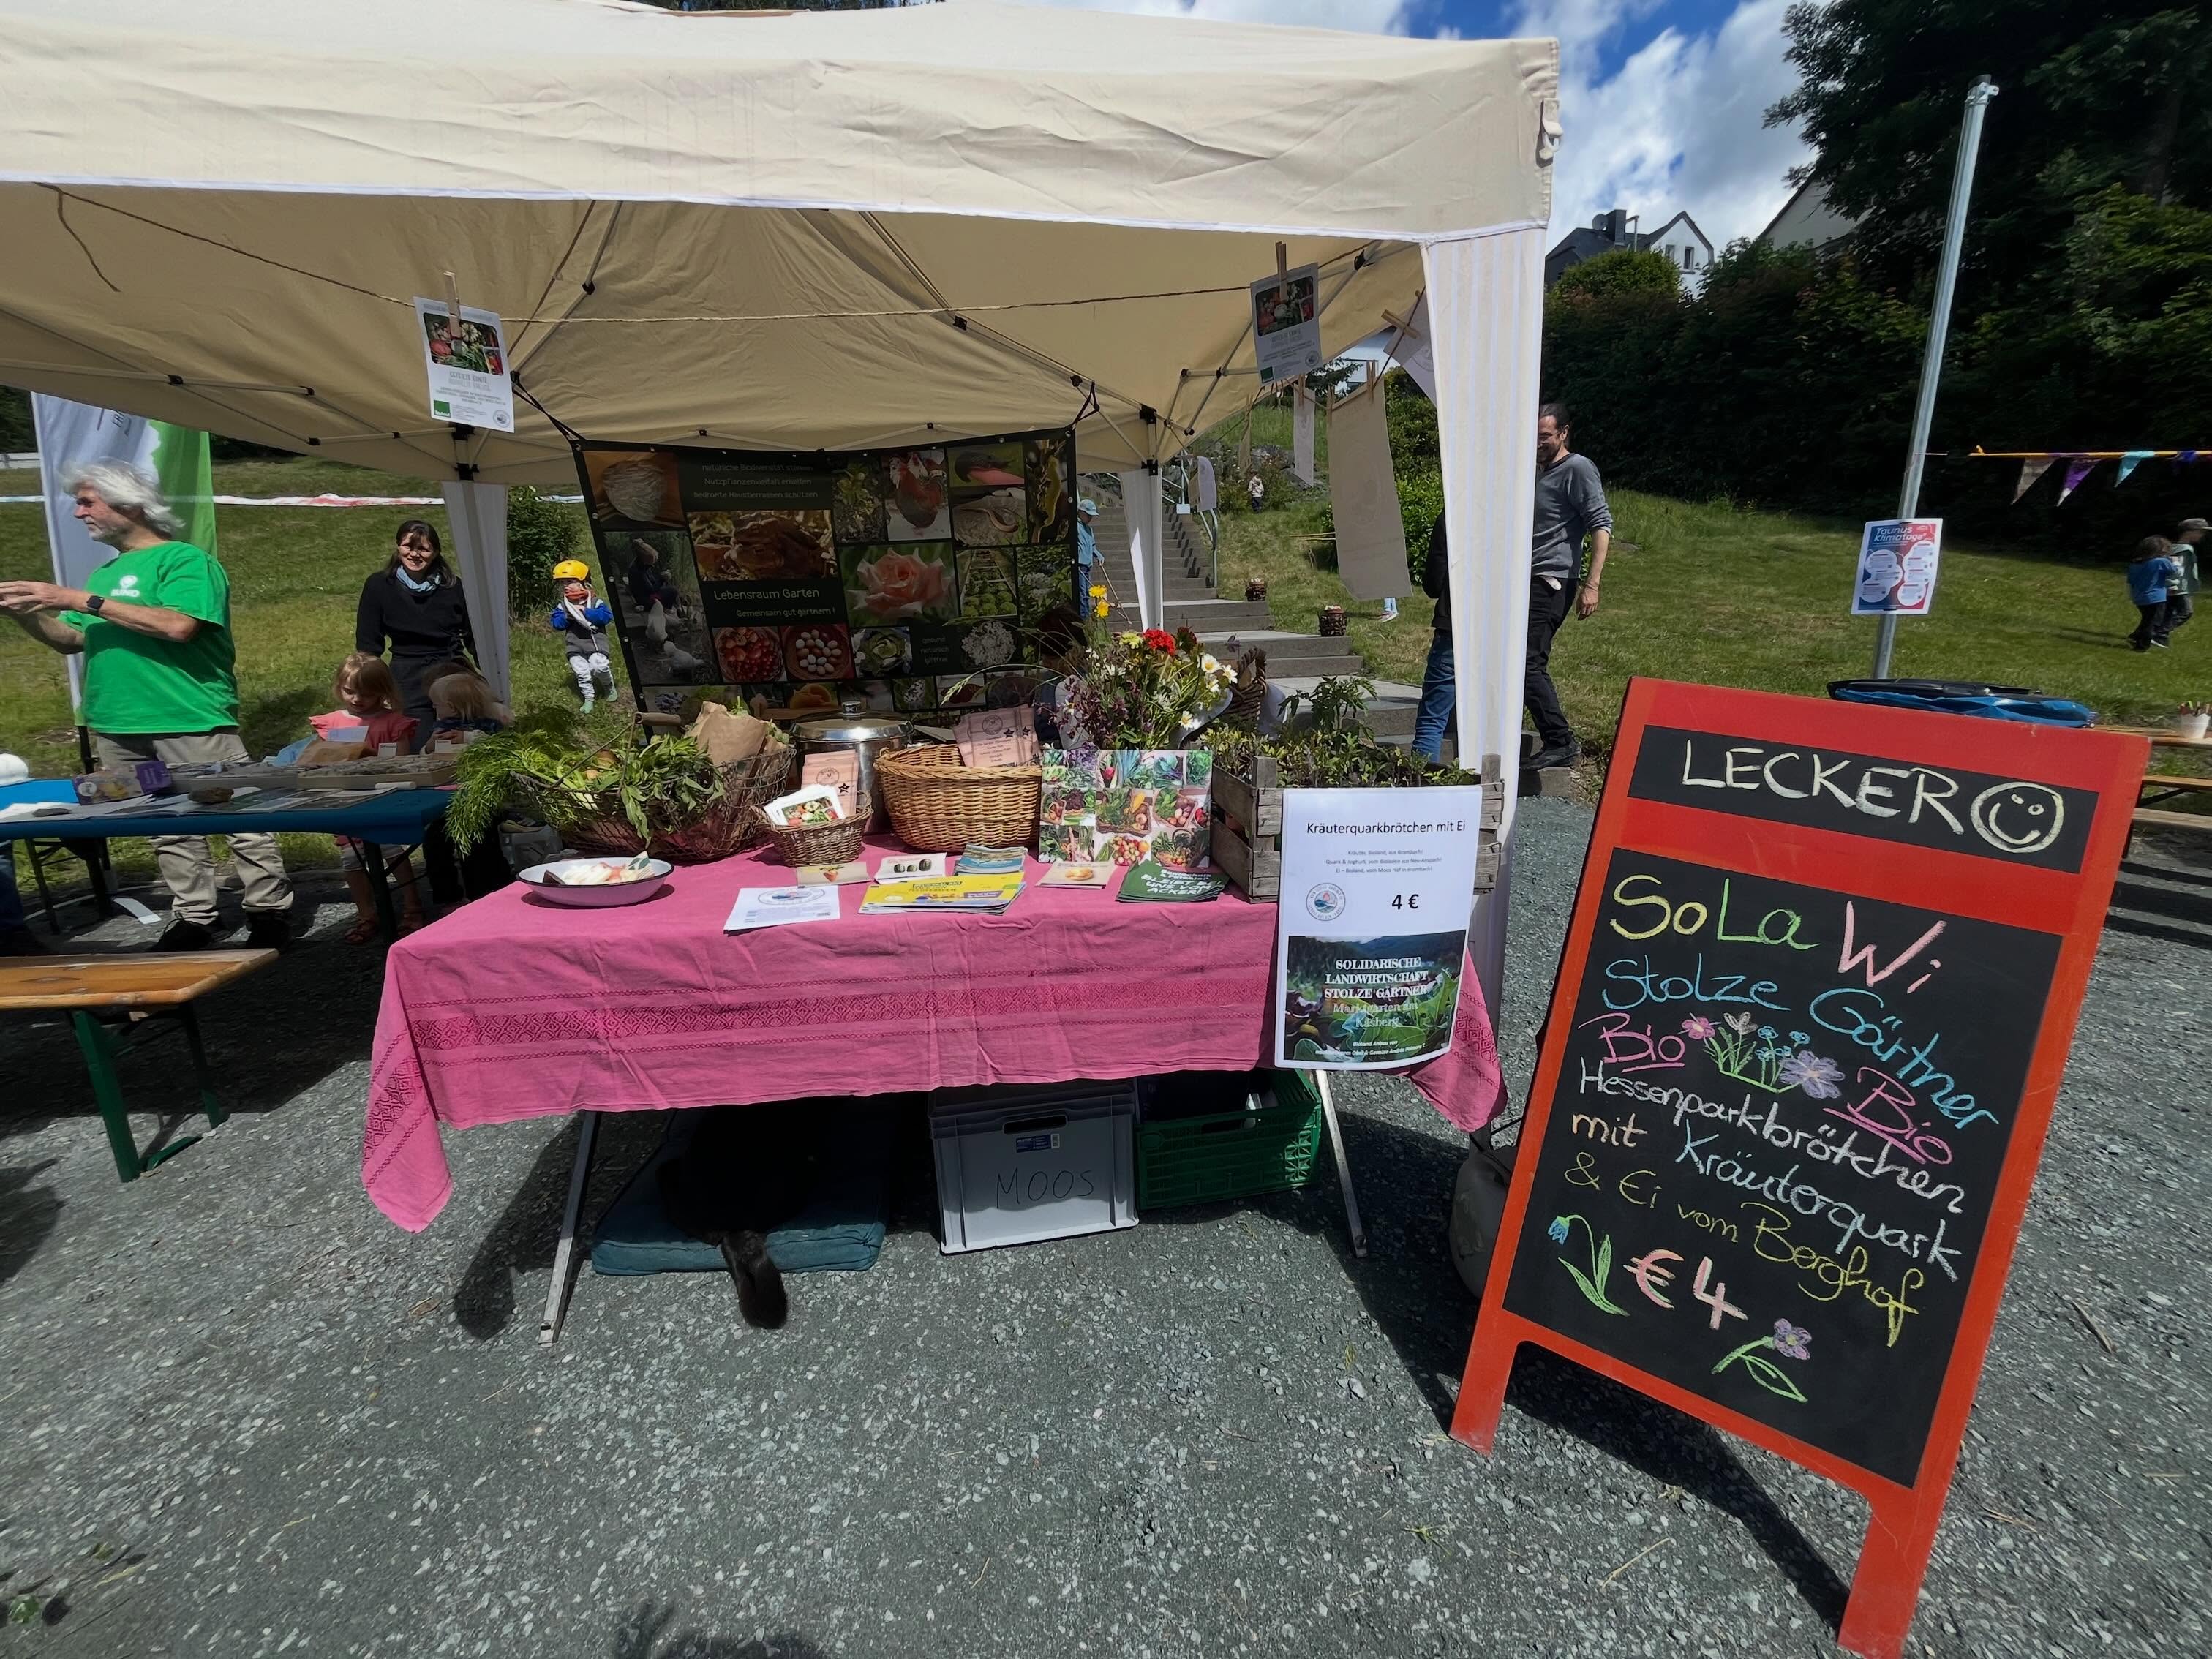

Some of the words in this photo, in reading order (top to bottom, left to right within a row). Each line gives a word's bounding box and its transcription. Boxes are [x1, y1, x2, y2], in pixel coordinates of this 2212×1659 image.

[1877, 527, 1913, 535] Taunus
[713, 590, 780, 601] Lebensraum
[782, 588, 820, 598] Garten
[736, 609, 781, 617] Gemeinsam
[783, 609, 797, 618] gut
[1682, 739, 1965, 835] LECKER
[1306, 821, 1433, 835] Kräuterquarkbrötchen
[1436, 821, 1454, 832] mit
[1456, 820, 1466, 832] Ei
[1146, 881, 1176, 889] UNS
[1391, 895, 1402, 910] 4
[1408, 894, 1419, 910] €
[1336, 957, 1421, 970] SOLIDARISCHE
[1325, 971, 1429, 985] LANDWIRTSCHAFT
[1324, 988, 1373, 999] STOLZE
[1579, 1012, 1685, 1064] Bio
[1602, 952, 1791, 1011] Stolze
[1809, 988, 1999, 1129] Gärtner
[1848, 1066, 1952, 1165] Bio
[1572, 1113, 1647, 1148] mit
[1580, 1056, 1965, 1214] Hessenparkbrötchen
[996, 1167, 1094, 1209] MOOS
[1563, 1151, 1601, 1191] &
[1677, 1203, 1739, 1242] vom
[1740, 1201, 1925, 1347] Berghof
